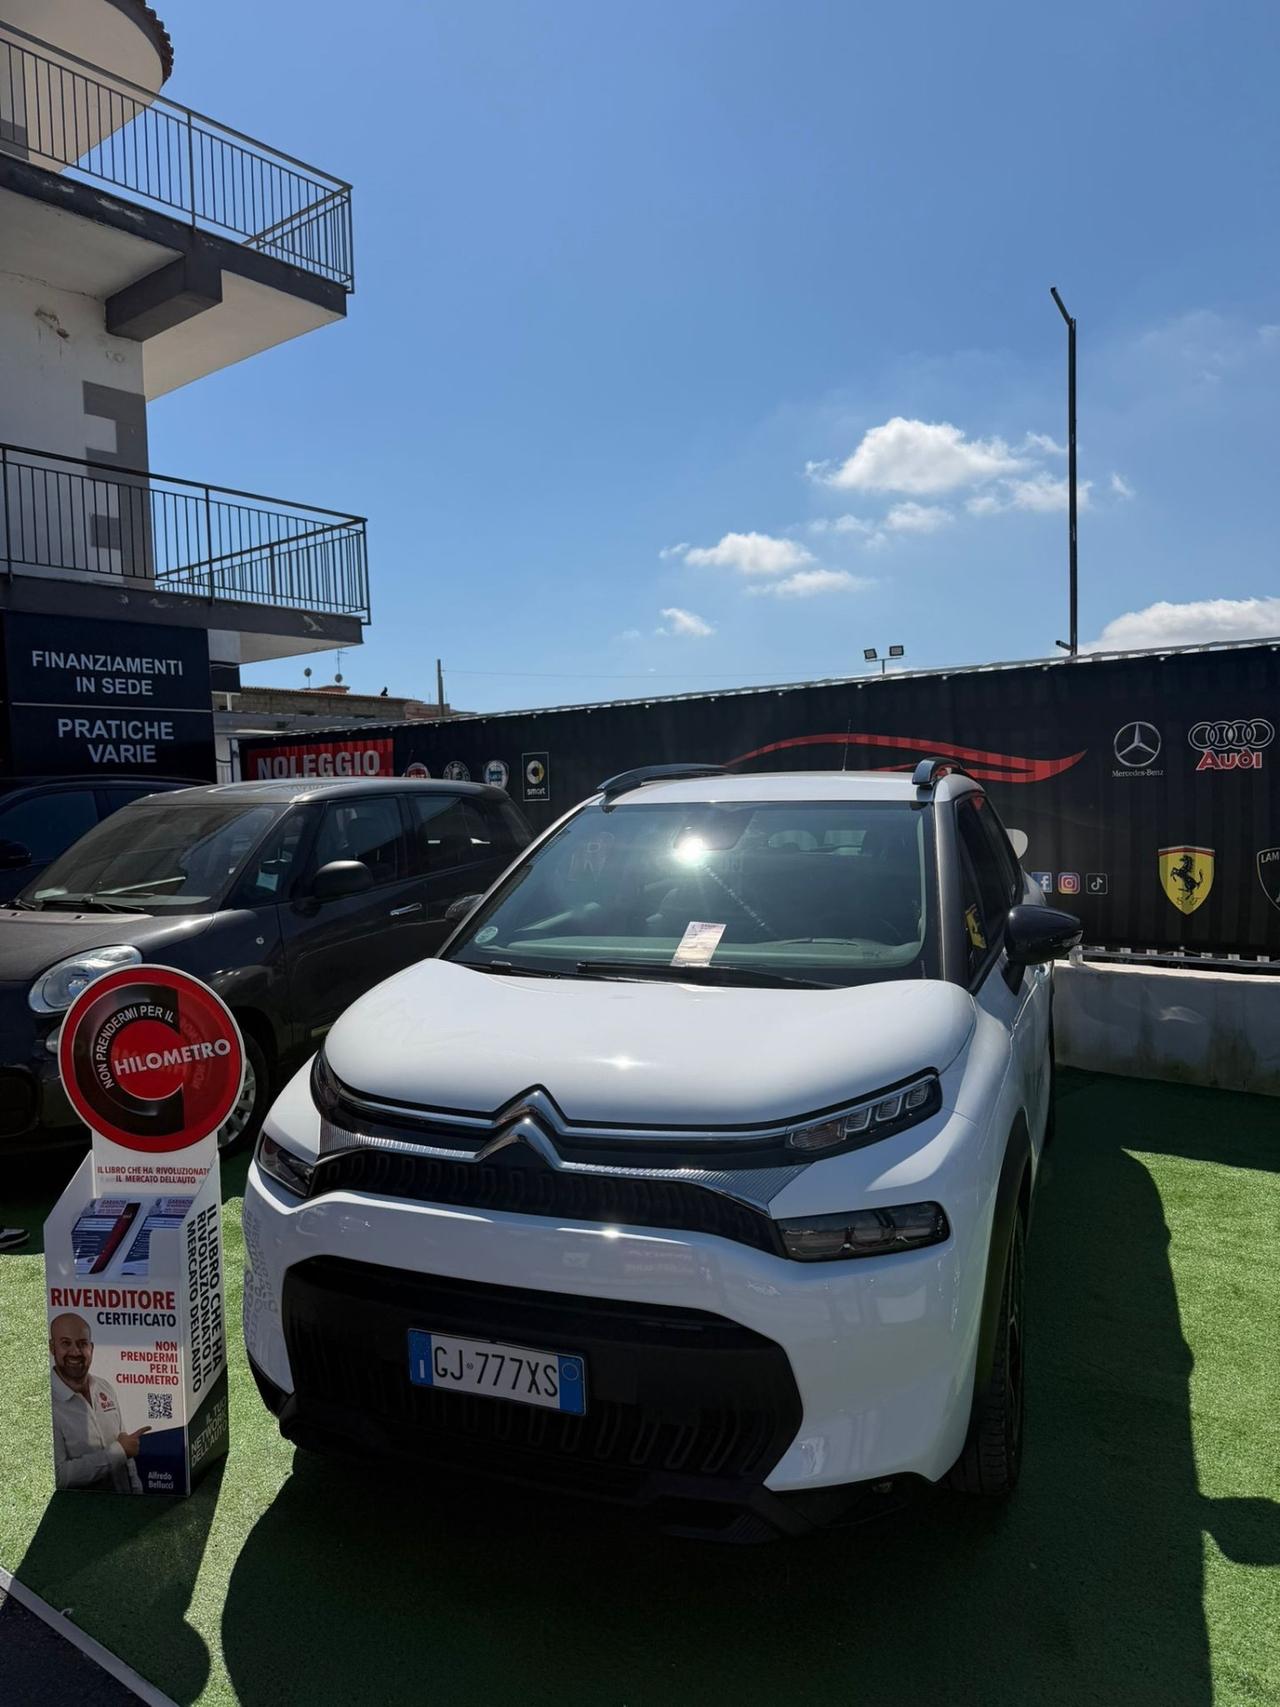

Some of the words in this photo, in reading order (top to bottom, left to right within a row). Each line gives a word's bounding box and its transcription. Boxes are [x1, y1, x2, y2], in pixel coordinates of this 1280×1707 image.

[31, 650, 183, 676] FINANZIAMENTI
[76, 676, 96, 693] IN
[102, 678, 153, 696] SEDE
[57, 718, 174, 740] PRATICHE
[88, 744, 157, 763] VARIE
[257, 750, 381, 780] NOLEGGIO
[1112, 769, 1164, 778] Mercedes-Benz
[527, 787, 546, 795] smart
[140, 1005, 163, 1018] PER
[165, 1010, 174, 1023] IL
[96, 1006, 139, 1061] PRENDERMI
[97, 1063, 115, 1089] NON
[105, 1166, 126, 1174] LIBRO
[127, 1166, 141, 1174] CHE
[125, 1175, 158, 1183] MERCATO
[160, 1175, 196, 1184] DELL'AUTO
[207, 1203, 217, 1226] IL
[187, 1219, 198, 1302] MERCATO
[208, 1225, 219, 1289] LIBRO
[197, 1210, 211, 1360] RIVOLUZIONATO
[50, 1288, 176, 1310] RIVENDITORE
[96, 1311, 176, 1328] CERTIFICATO
[211, 1293, 221, 1337] CHE
[155, 1341, 178, 1351] NON
[190, 1304, 201, 1393] DELL'AUTO
[212, 1336, 222, 1372] HA
[120, 1351, 178, 1363] PRENDERMI
[150, 1363, 168, 1374] PER
[170, 1364, 179, 1374] IL
[203, 1362, 212, 1383] IL
[116, 1373, 179, 1386] CHILOMETRO
[147, 1471, 172, 1481] Alfredo
[148, 1480, 174, 1489] Bellucci
